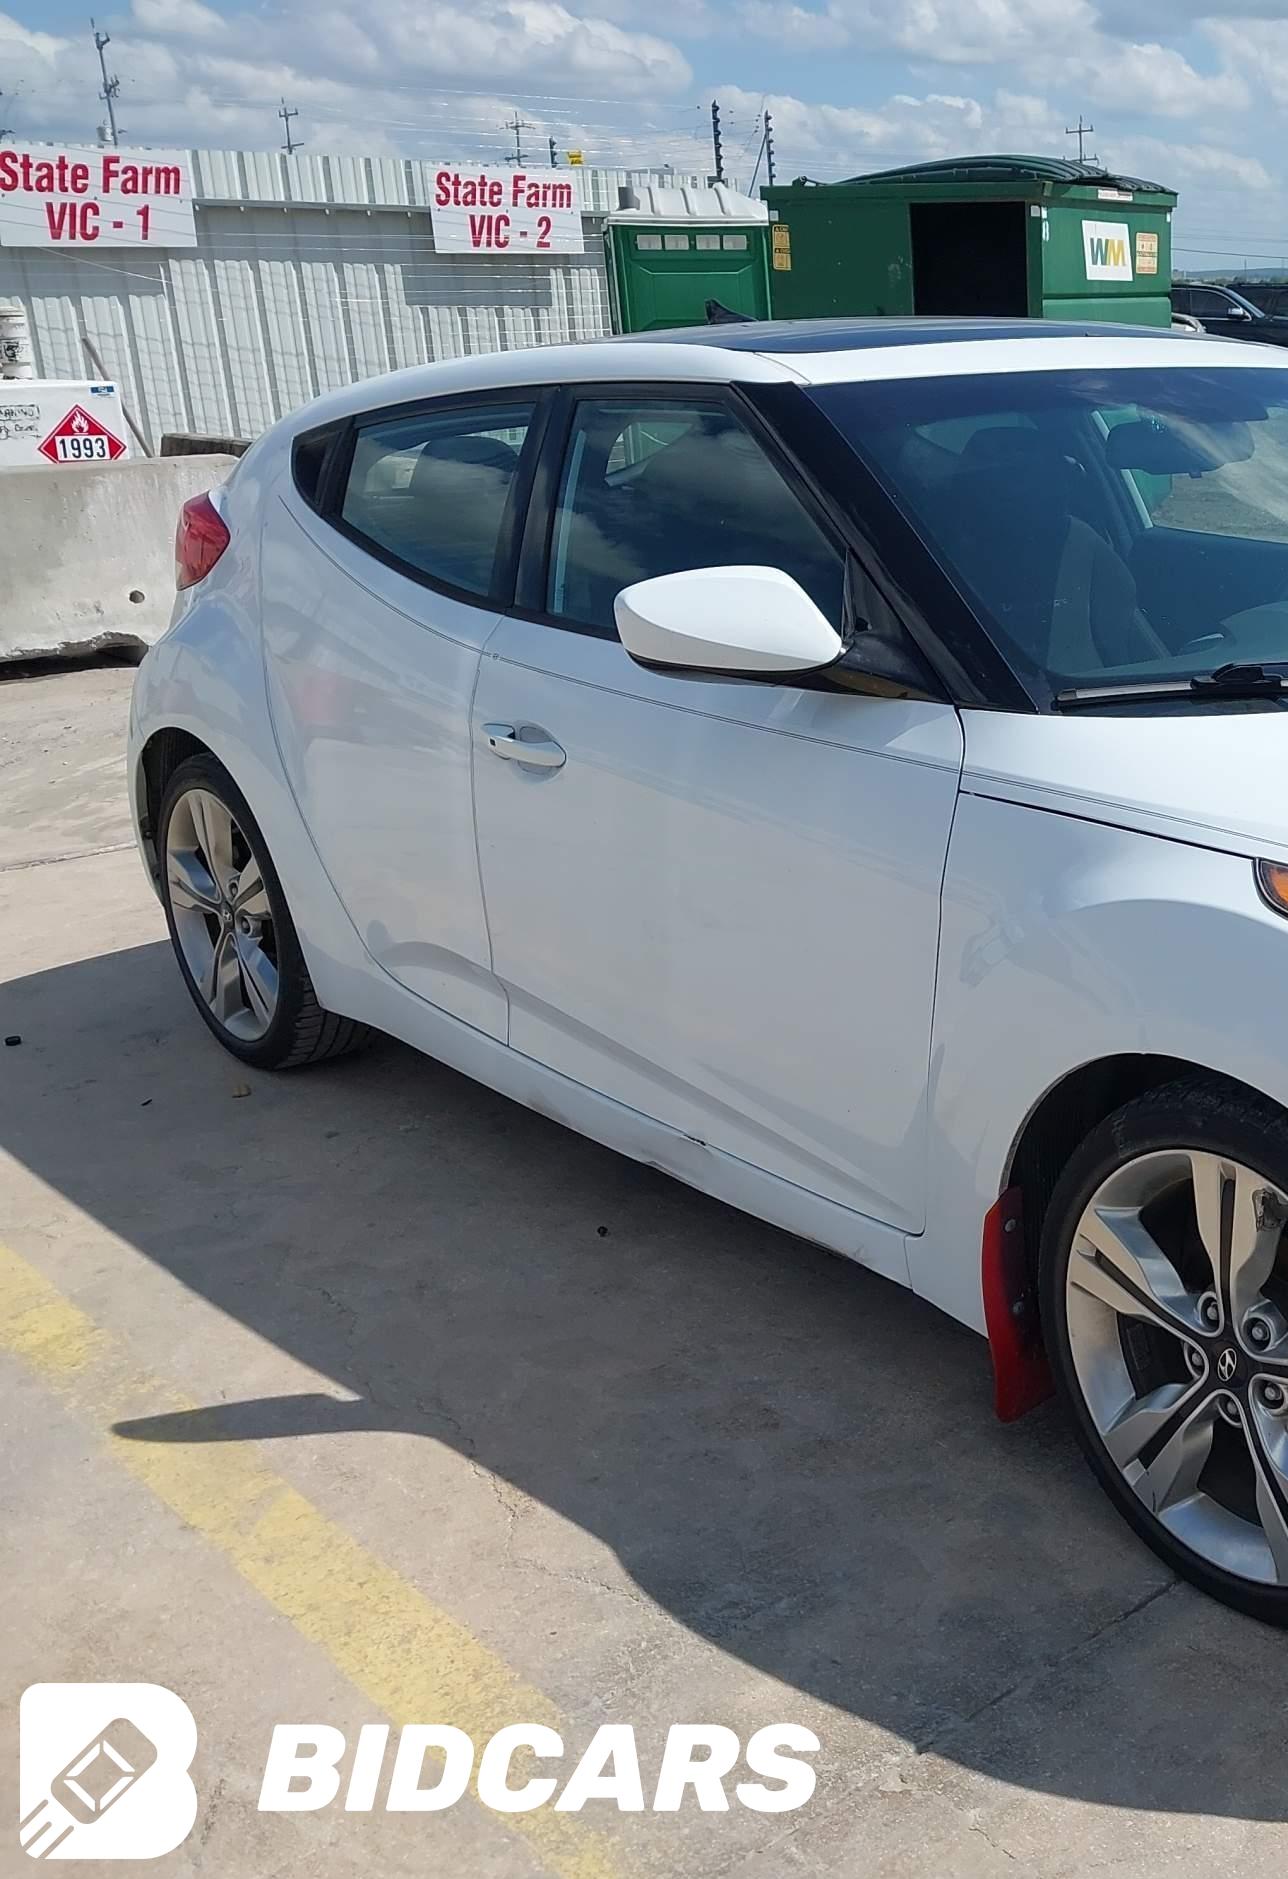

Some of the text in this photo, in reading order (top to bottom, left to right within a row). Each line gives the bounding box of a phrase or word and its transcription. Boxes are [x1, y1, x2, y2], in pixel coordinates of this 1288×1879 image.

[0, 150, 181, 195] State Farm
[435, 171, 572, 208] State Farm
[45, 202, 149, 241] VIC - 1
[469, 214, 552, 248] VIC - 2
[1090, 237, 1126, 267] WM
[59, 437, 106, 459] 1993
